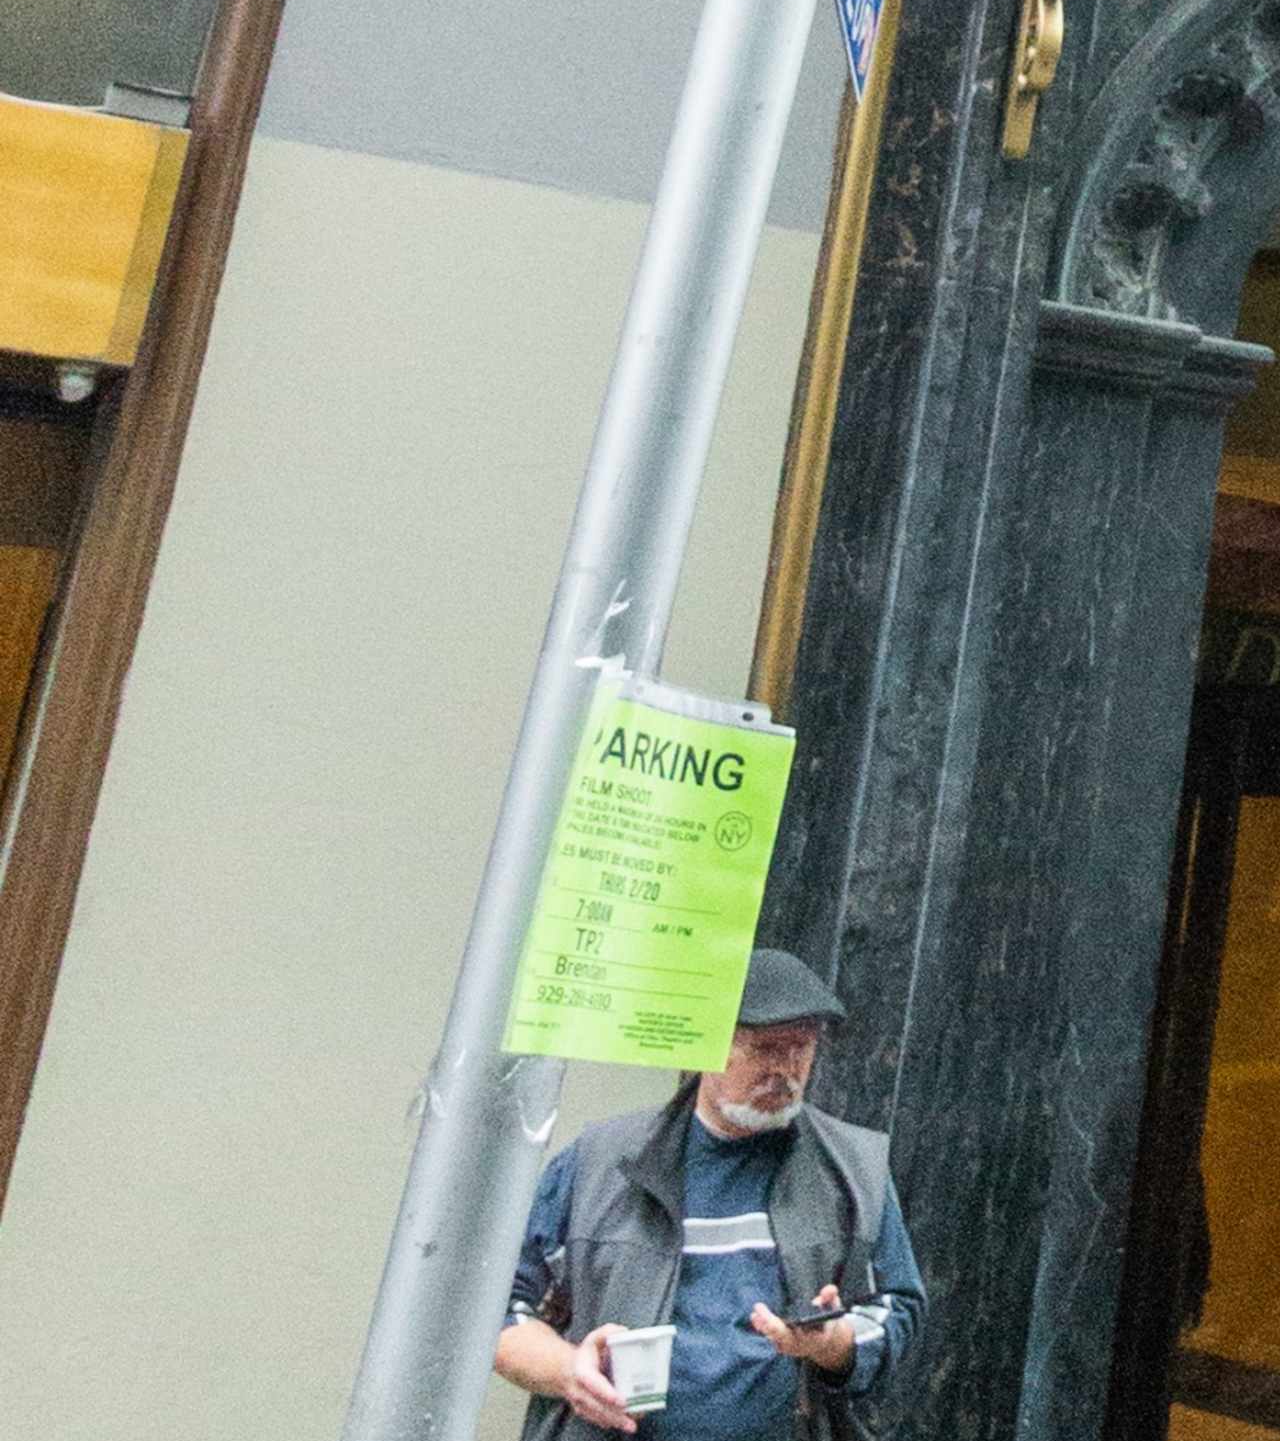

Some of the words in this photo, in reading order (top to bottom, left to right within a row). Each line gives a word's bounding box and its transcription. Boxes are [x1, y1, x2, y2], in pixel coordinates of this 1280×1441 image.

[595, 726, 746, 791] ARKING
[580, 776, 613, 795] FILM
[579, 846, 610, 863] MUST
[629, 878, 661, 902] 2/20
[575, 927, 605, 956] TP2
